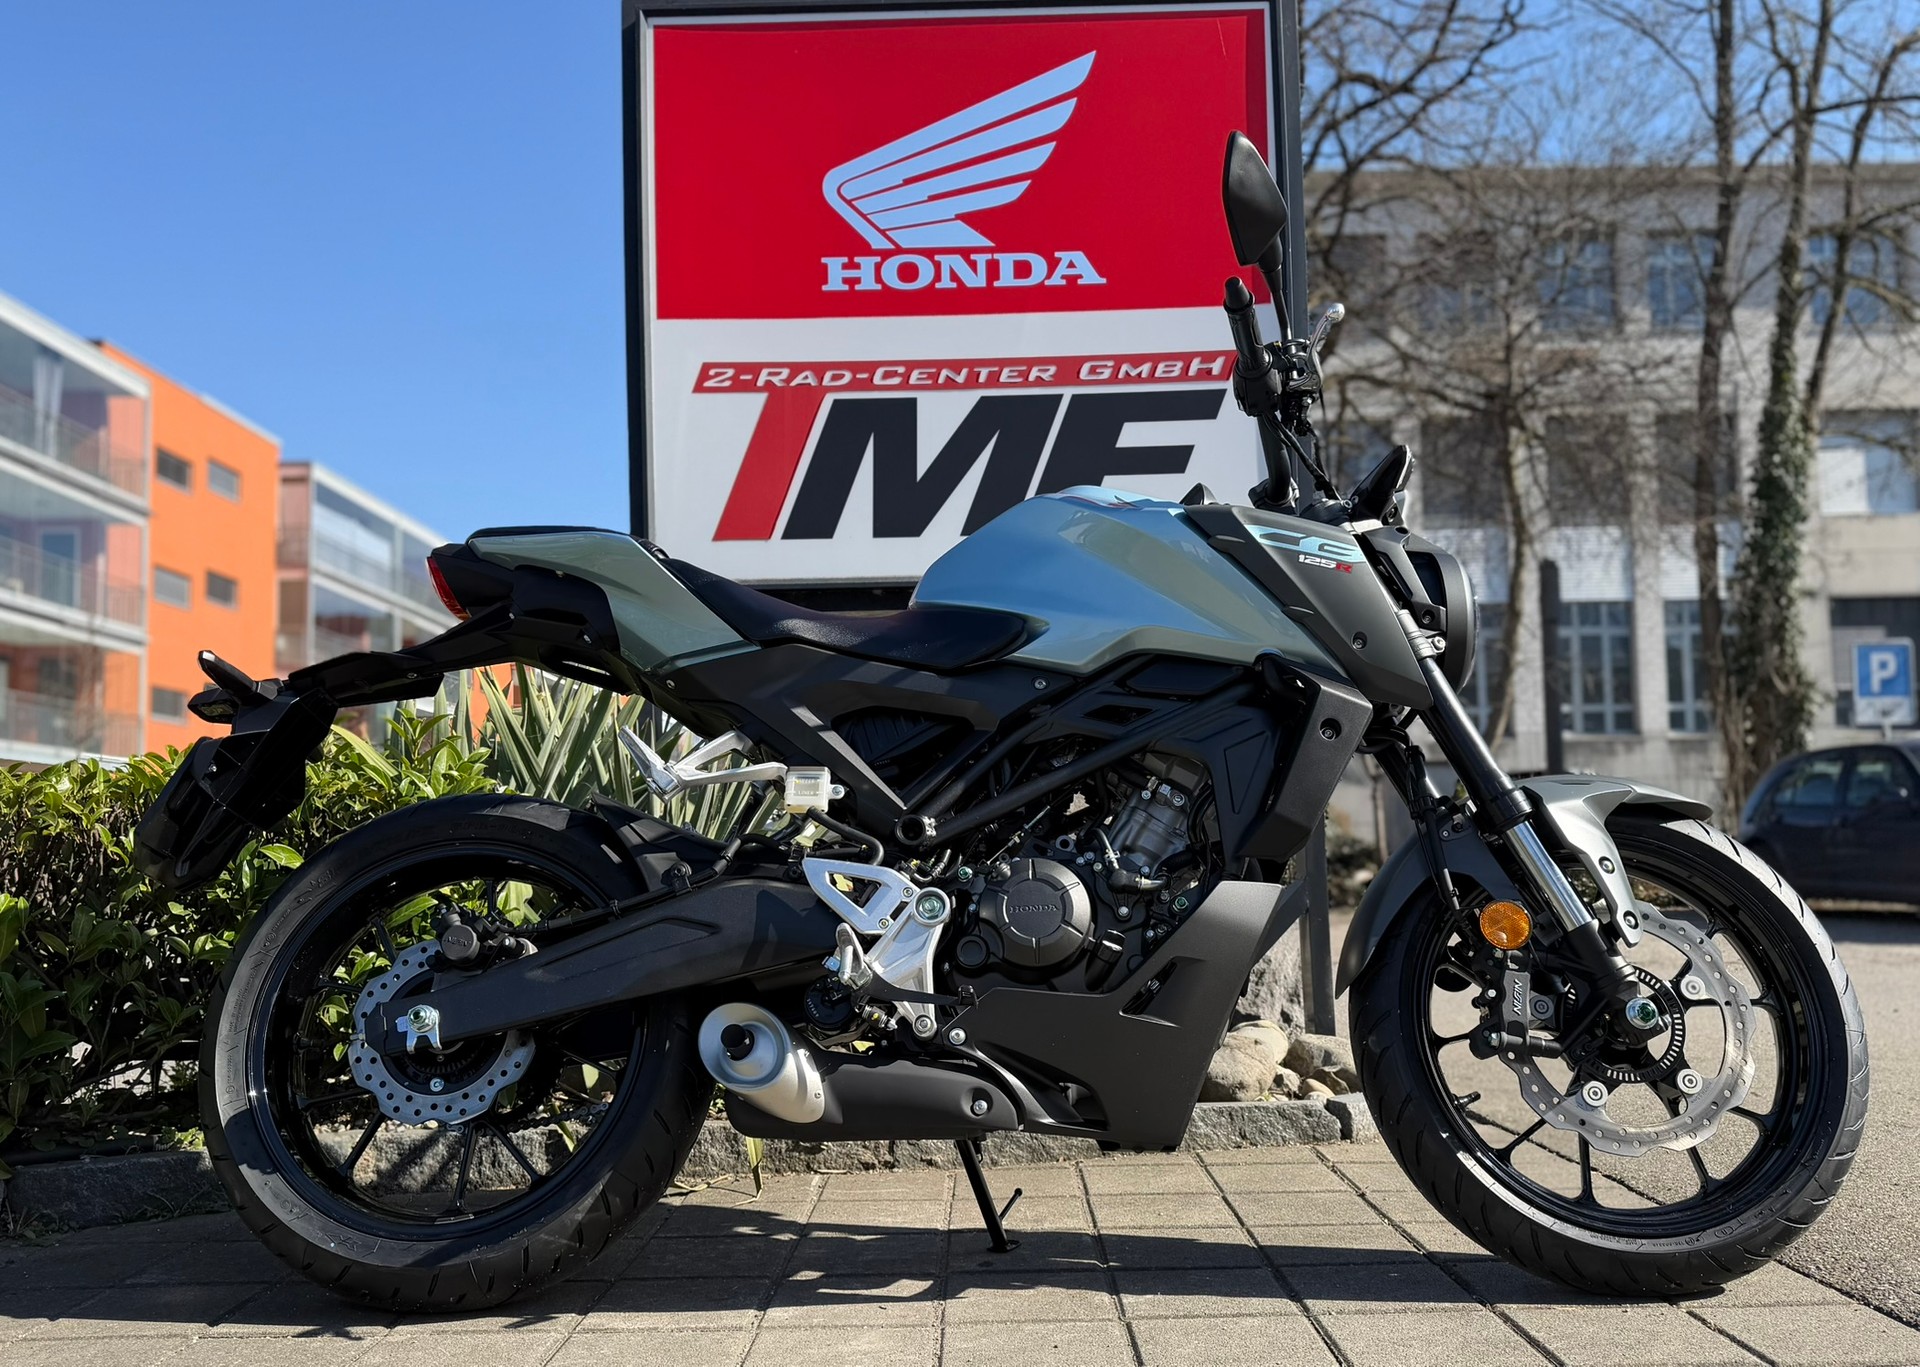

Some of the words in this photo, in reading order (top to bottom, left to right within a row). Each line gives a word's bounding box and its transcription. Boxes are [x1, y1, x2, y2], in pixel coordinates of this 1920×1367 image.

[821, 250, 1107, 292] HONDA
[1298, 553, 1353, 574] 125R
[1869, 651, 1898, 694] P
[1009, 903, 1060, 914] HONDA
[1512, 978, 1524, 1016] NISSIN
